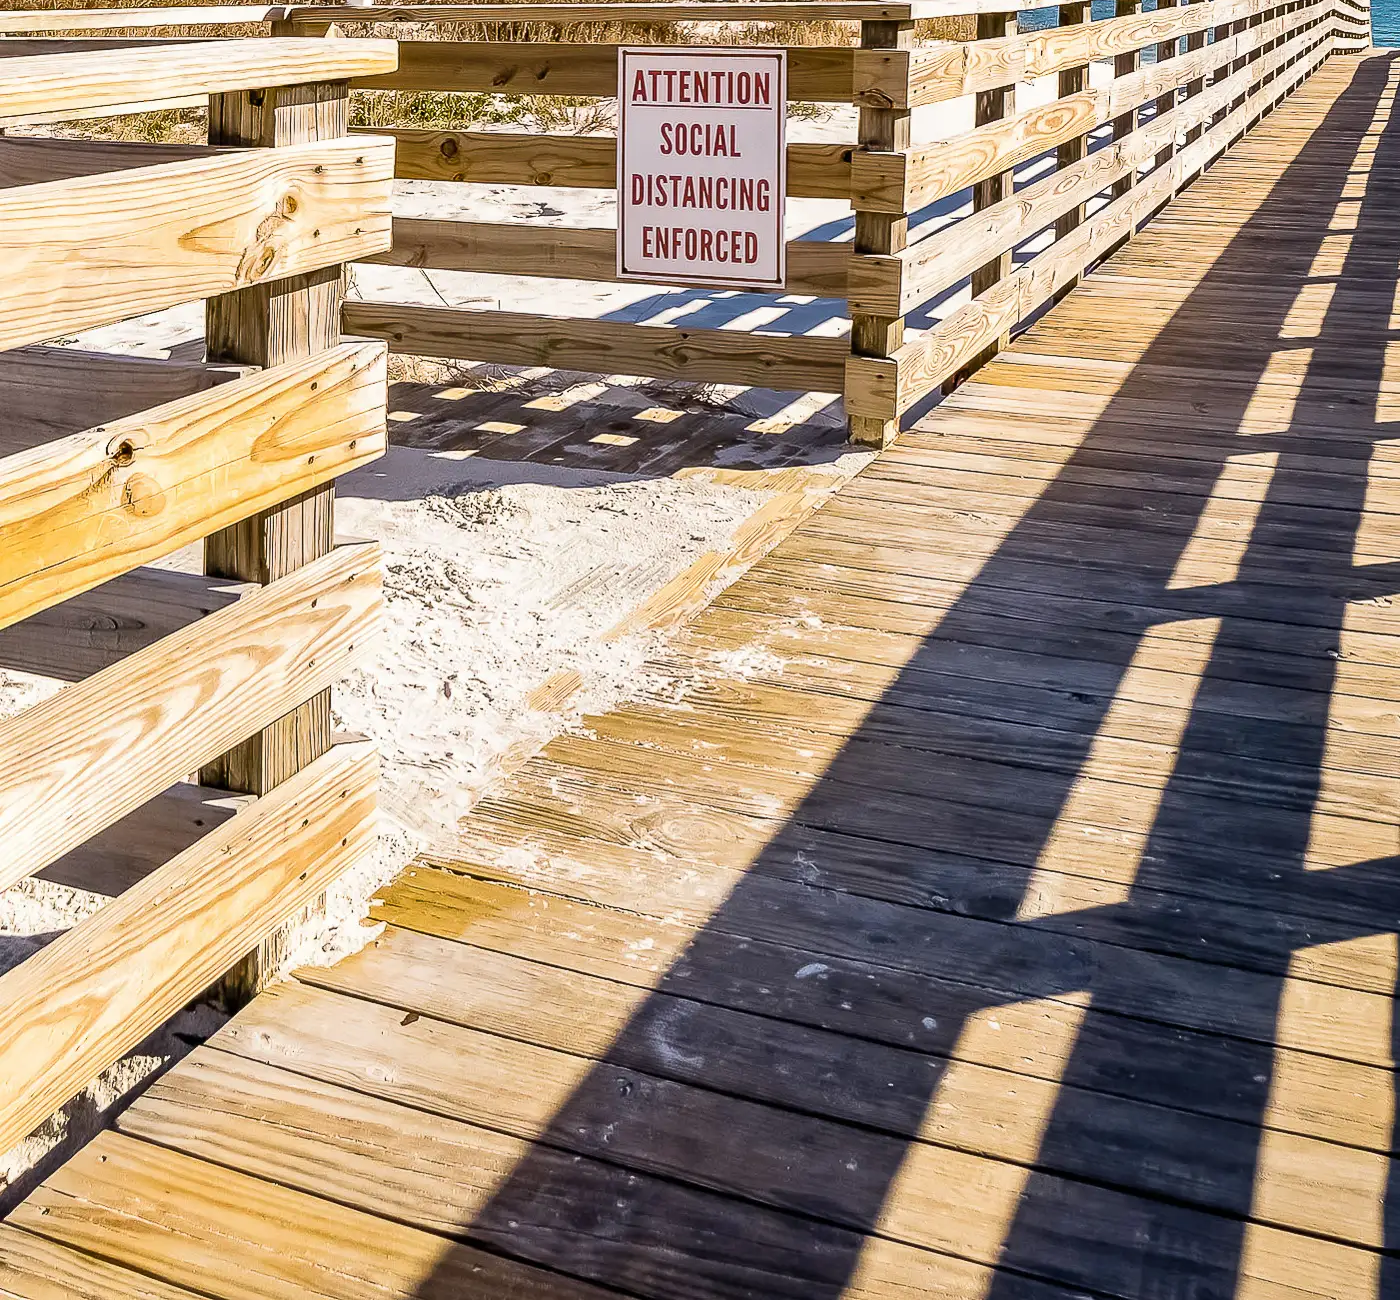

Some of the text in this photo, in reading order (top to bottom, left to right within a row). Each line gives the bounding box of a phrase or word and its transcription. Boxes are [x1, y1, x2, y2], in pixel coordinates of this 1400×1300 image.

[632, 70, 770, 105] ATTENTION
[660, 122, 741, 157] SOCIAL
[632, 173, 770, 212] DISTANCING
[642, 226, 758, 264] ENFORCED
